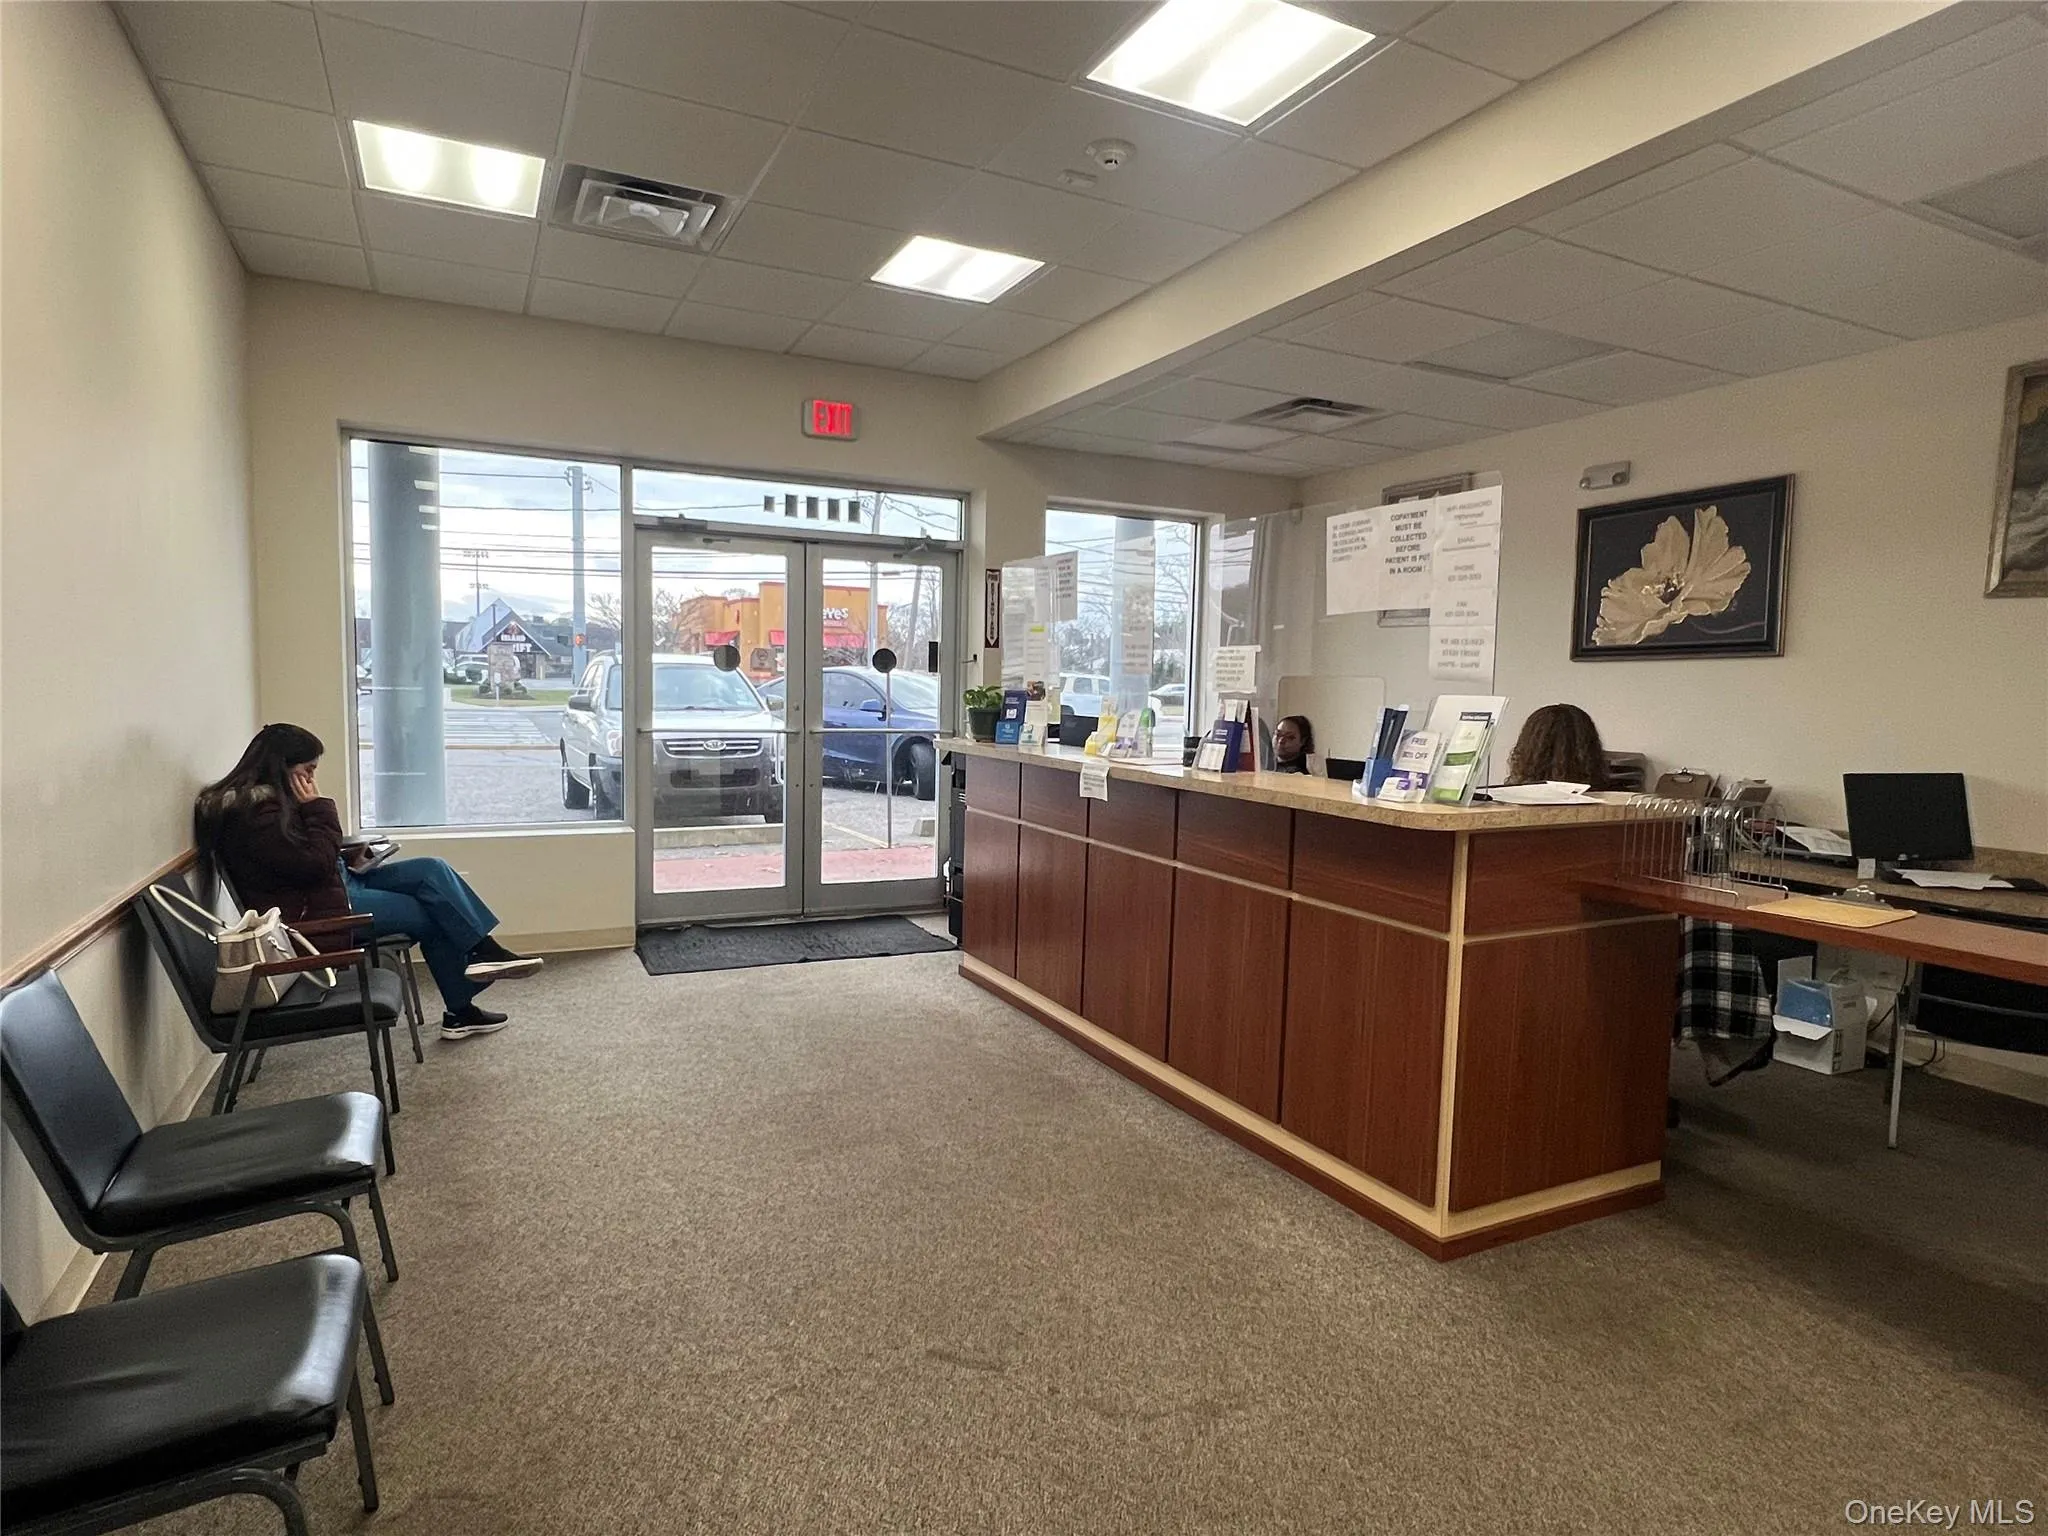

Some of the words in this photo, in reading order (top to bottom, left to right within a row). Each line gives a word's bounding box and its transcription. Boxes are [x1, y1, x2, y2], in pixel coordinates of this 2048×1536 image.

[813, 400, 852, 436] EXIT
[1391, 510, 1427, 521] COPAYMENT
[1395, 523, 1411, 531] MUST
[1413, 522, 1422, 530] BE
[1390, 532, 1427, 543] COLLECTED
[1396, 544, 1420, 552] BEFORE
[1385, 555, 1410, 564] PATIENT
[1419, 553, 1430, 561] PUT
